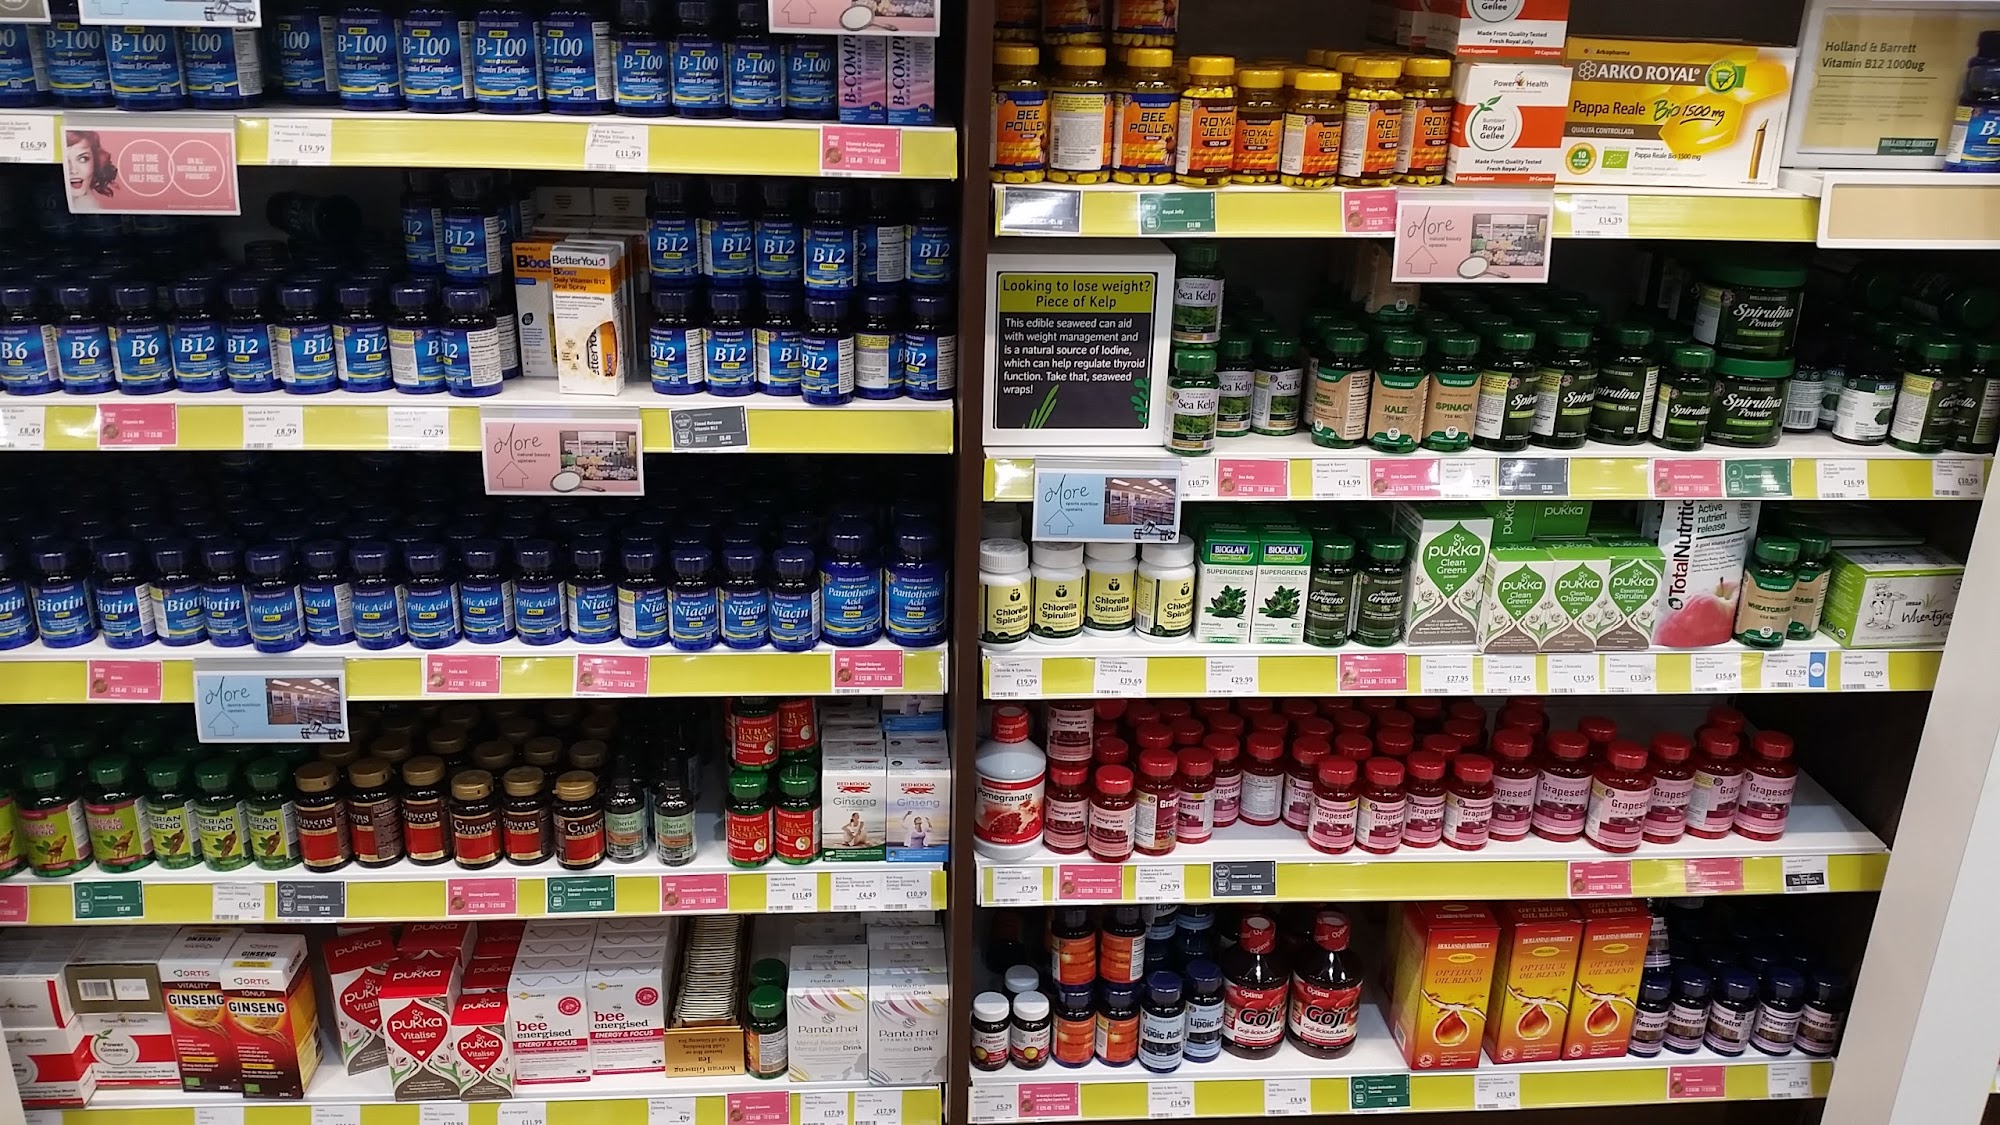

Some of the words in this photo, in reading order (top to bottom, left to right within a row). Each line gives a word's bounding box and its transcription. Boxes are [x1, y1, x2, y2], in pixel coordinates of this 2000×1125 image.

[338, 35, 386, 53] B-100
[403, 37, 450, 55] B-100
[477, 39, 526, 56] B-100
[1826, 42, 1866, 52] Holland
[1871, 43, 1877, 52] &
[1880, 43, 1916, 52] Barrett
[1822, 58, 1861, 68] Vitamin
[1865, 59, 1883, 68] B12
[1887, 60, 1925, 71] 1000ug
[1597, 64, 1642, 79] ARKO
[1494, 80, 1516, 88] Power
[1017, 110, 1039, 119] BEE
[1141, 112, 1164, 122] BEE
[1573, 101, 1609, 116] Pappa
[1613, 102, 1645, 115] Reale
[1654, 100, 1680, 121] Bio
[1682, 105, 1710, 116] 1500
[1712, 108, 1724, 125] mg
[1200, 117, 1235, 126] ROYAL
[1202, 128, 1231, 137] JELLY
[21, 141, 46, 149] £16.99
[1407, 207, 1455, 244] More
[656, 236, 688, 251] B12
[764, 240, 795, 254] B12
[552, 256, 597, 266] BetterYou
[1003, 280, 1051, 293] Looking
[1057, 282, 1068, 291] to
[1073, 281, 1098, 291] lose
[1102, 280, 1150, 294] weight?
[1178, 290, 1192, 299] Sea
[1195, 291, 1216, 302] Kelp
[1036, 296, 1068, 307] Piece
[1073, 296, 1085, 307] of
[1090, 296, 1116, 310] Kelp
[1732, 304, 1793, 321] Spirulina
[1005, 318, 1024, 328] This
[1026, 319, 1054, 328] edible
[1057, 319, 1096, 328] seaweed
[1099, 320, 1115, 328] can
[1118, 319, 1132, 328] aid
[1748, 318, 1782, 328] Powder
[1005, 332, 1024, 341] with
[1026, 332, 1057, 344] weight
[1059, 334, 1119, 344] management
[1121, 332, 1138, 341] and
[71, 341, 99, 359] B6
[131, 338, 159, 357] B6
[1004, 345, 1012, 354] is
[1022, 345, 1054, 355] natural
[1057, 347, 1087, 355] source
[1089, 345, 1099, 355] of
[1102, 346, 1132, 356] Iodine,
[1004, 359, 1030, 368] which
[1052, 359, 1071, 370] help
[1074, 359, 1111, 370] regulate
[1114, 359, 1145, 370] thyroid
[1004, 372, 1043, 381] function.
[1047, 372, 1066, 381] Take
[1069, 372, 1089, 382] that,
[1092, 372, 1131, 381] seaweed
[1003, 385, 1033, 396] wraps!
[1178, 398, 1193, 409] Sea
[1197, 399, 1215, 411] Kelp
[1385, 405, 1408, 414] KALE
[1436, 402, 1472, 410] SPINACH
[494, 424, 541, 460] More
[1698, 503, 1723, 514] Active
[1698, 512, 1727, 523] nutrient
[1697, 522, 1725, 533] release
[1215, 545, 1244, 554] BIOGLAN
[1268, 545, 1298, 554] BIOGLAN
[1428, 544, 1481, 560] pukka
[1441, 559, 1465, 567] Clean
[1436, 566, 1467, 575] Greens
[828, 586, 876, 598] Pantothenic
[38, 596, 84, 613] Biotin
[408, 602, 426, 612] Folic
[428, 601, 448, 611] Acid
[675, 601, 714, 615] Niacin
[1042, 603, 1076, 611] Chlorella
[1748, 602, 1791, 613] WHEATGRASS
[978, 788, 1032, 803] Pomegranate
[833, 796, 876, 807] Ginseng
[897, 797, 940, 808] Ginseng
[1317, 809, 1353, 820] Grapeseed
[792, 892, 812, 900] £11.49
[906, 890, 927, 898] £10.99
[1435, 968, 1483, 978] OPTIMUM
[1434, 976, 1451, 984] OIL
[1453, 976, 1482, 984] BLEND
[169, 994, 224, 1006] GINSENG
[1241, 989, 1263, 1000] Optima
[229, 1002, 285, 1013] GINSENG
[594, 1011, 624, 1022] bee
[1240, 1007, 1277, 1029] Goji
[595, 1019, 648, 1029] energised
[798, 1025, 833, 1033] Panta
[836, 1024, 858, 1033] rhei
[401, 1031, 436, 1040] Vitalise
